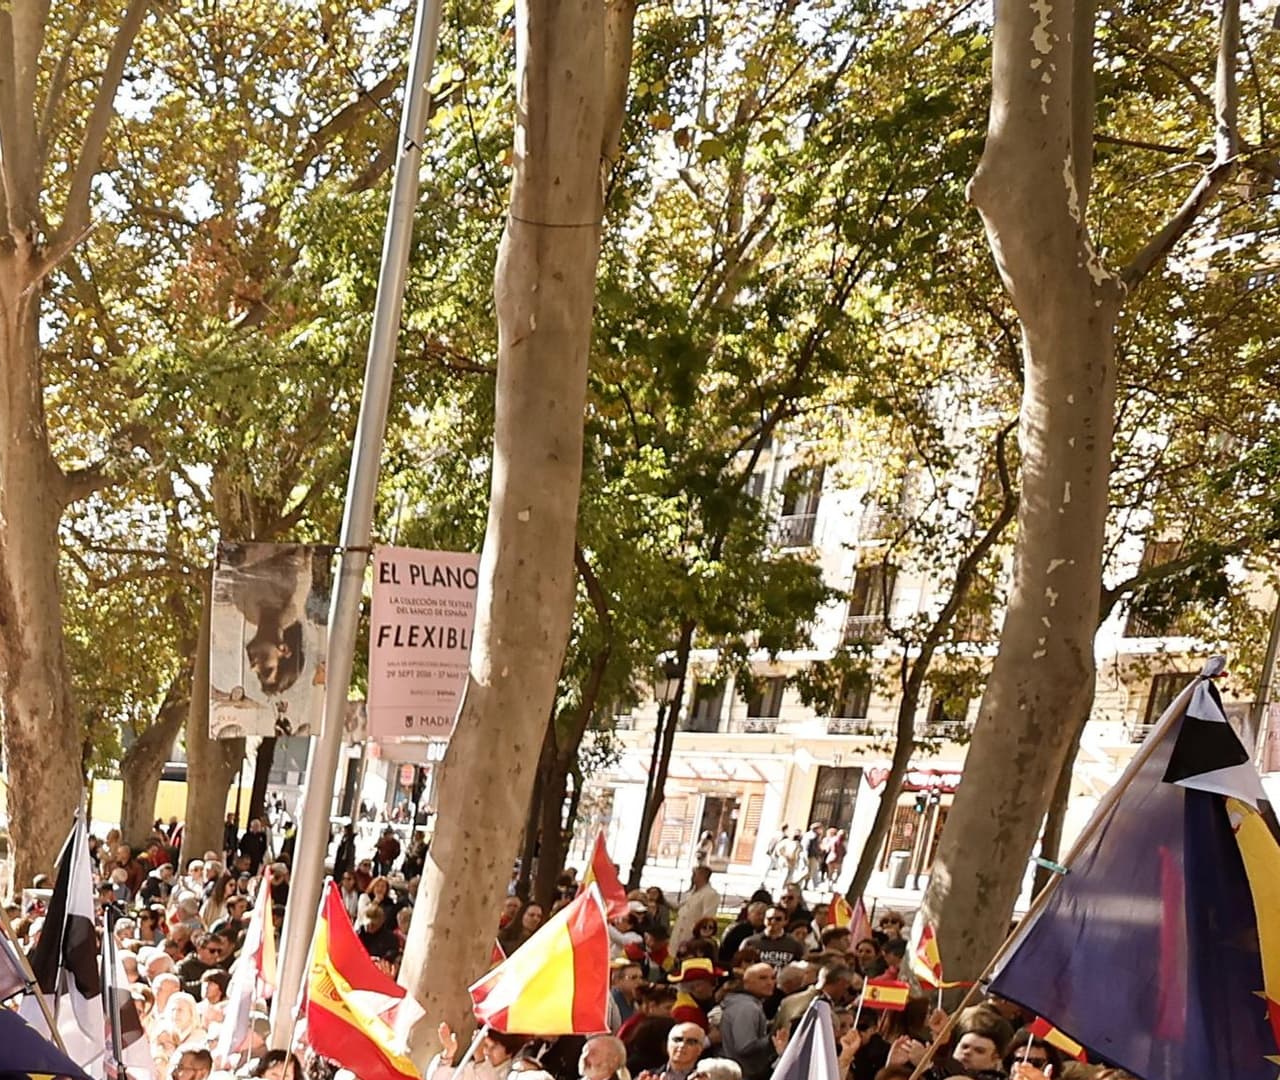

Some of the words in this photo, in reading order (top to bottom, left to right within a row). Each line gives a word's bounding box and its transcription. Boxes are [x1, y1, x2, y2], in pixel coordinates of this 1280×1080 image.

[379, 561, 401, 585] EL
[409, 564, 479, 590] PLANO
[377, 624, 473, 651] FLEXIBL
